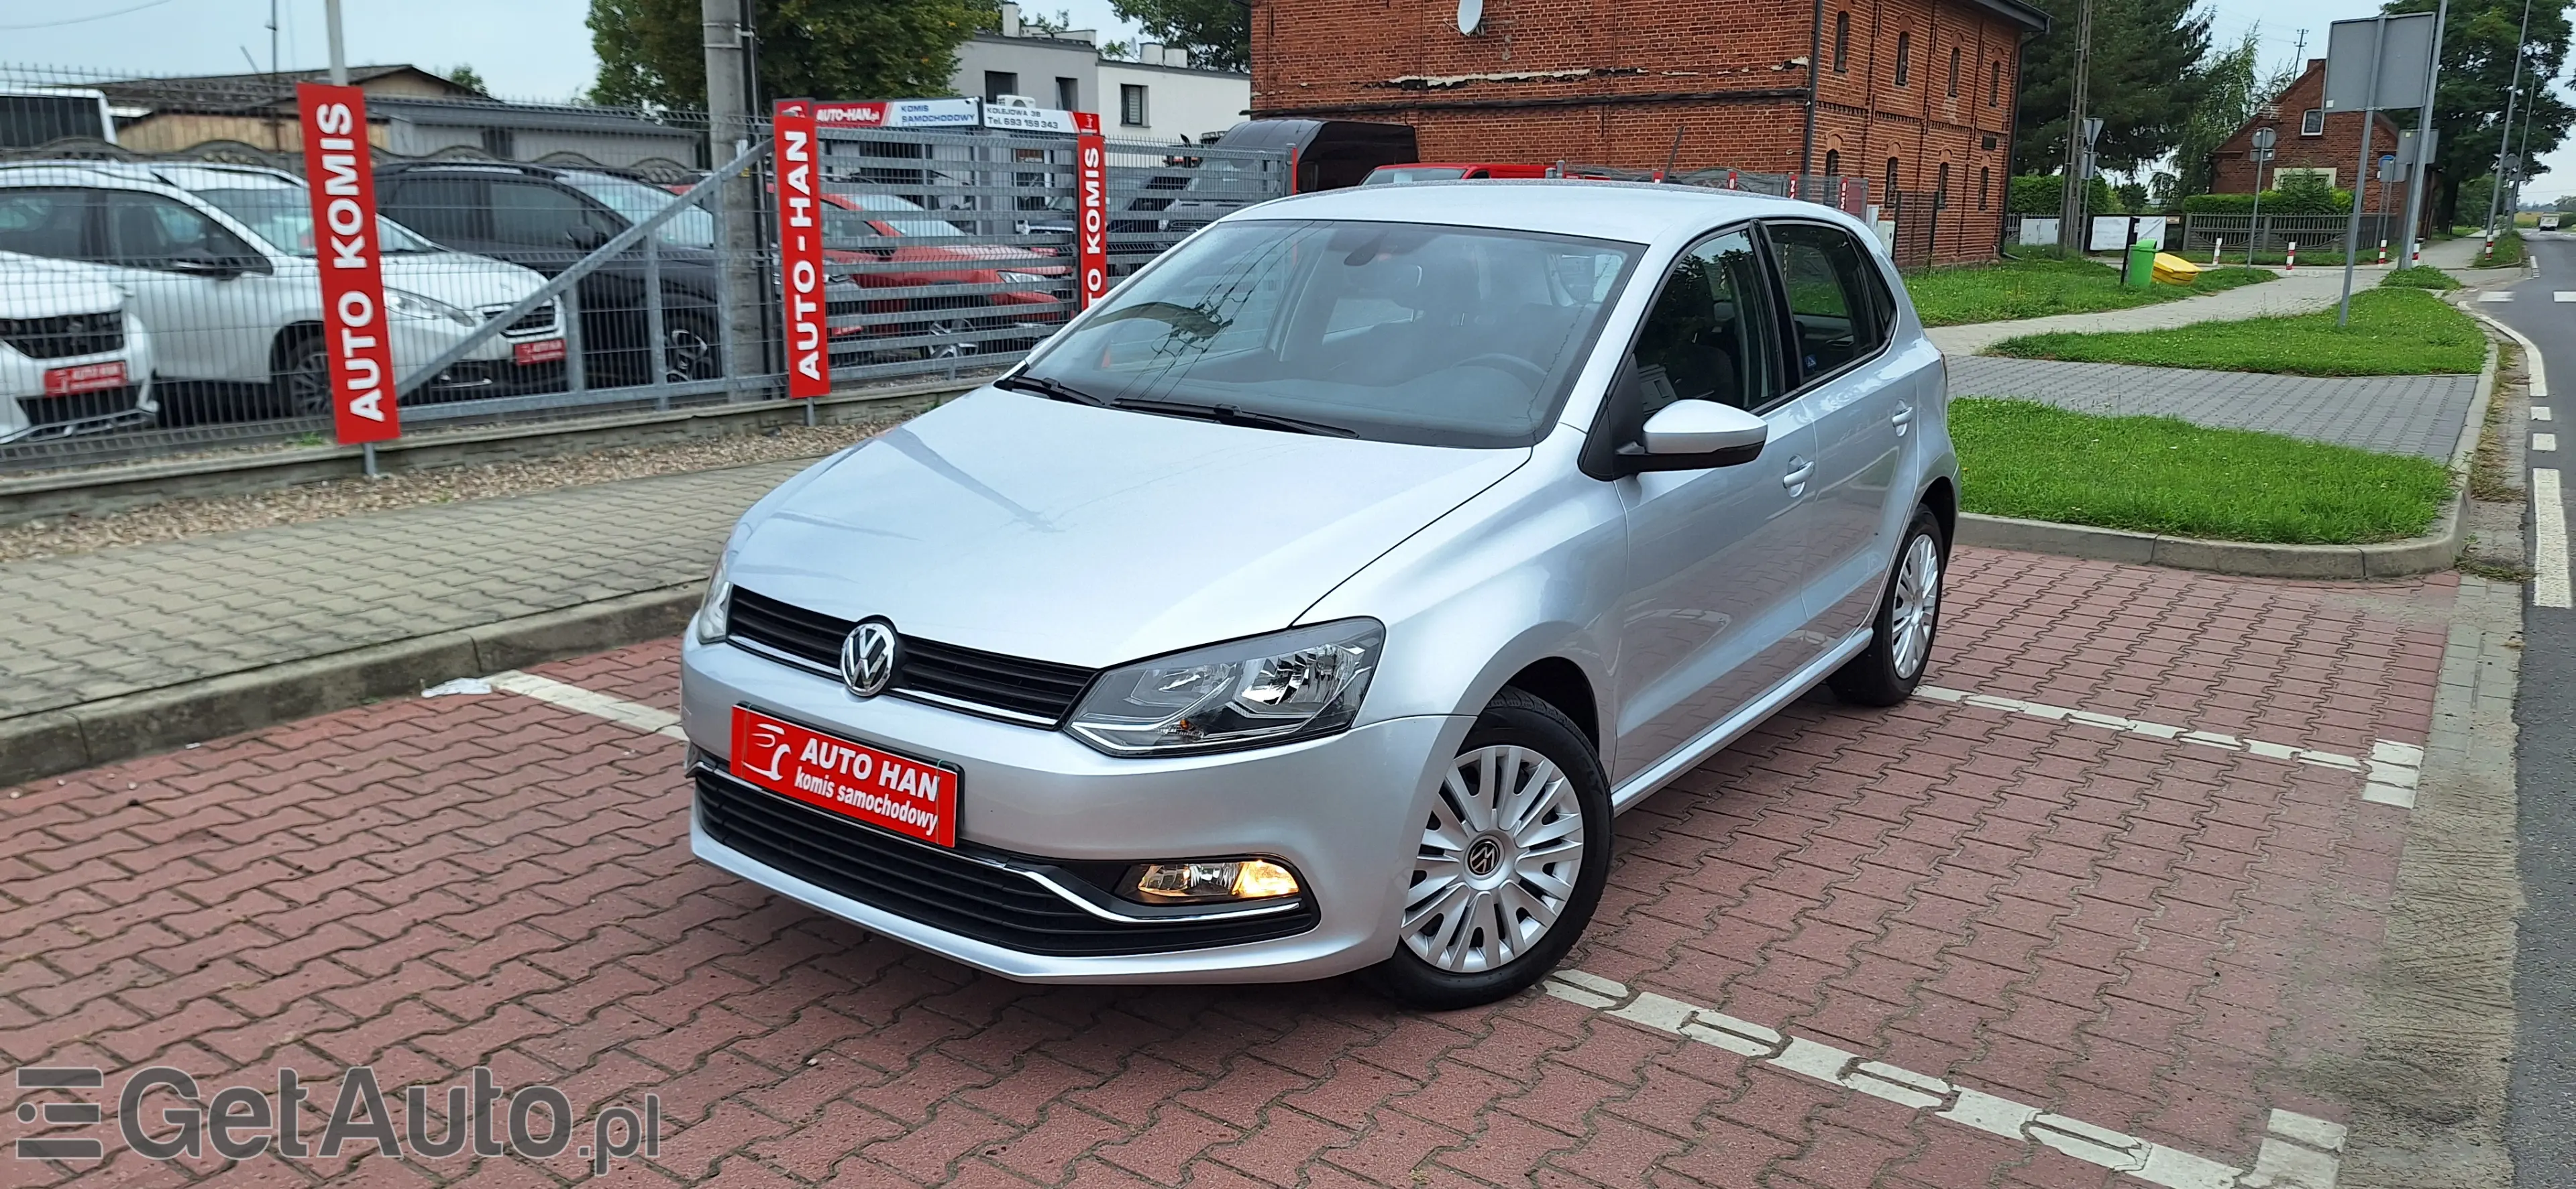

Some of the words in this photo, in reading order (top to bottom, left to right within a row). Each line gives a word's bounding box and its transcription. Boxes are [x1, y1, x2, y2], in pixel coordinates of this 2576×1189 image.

[901, 105, 929, 113] KOMIS
[902, 114, 975, 123] SAMOCHODOWY
[987, 107, 1028, 116] KOLEJOWA
[1024, 119, 1039, 127] 159
[1041, 121, 1059, 129] 343
[316, 102, 368, 270] KOMIS
[1084, 148, 1101, 254] KOMIS
[1087, 268, 1102, 308] TO
[338, 290, 386, 422] AUTO
[799, 738, 872, 780] AUTO
[878, 760, 941, 802] HAN
[794, 766, 835, 798] komis
[837, 784, 939, 836] samochodowy
